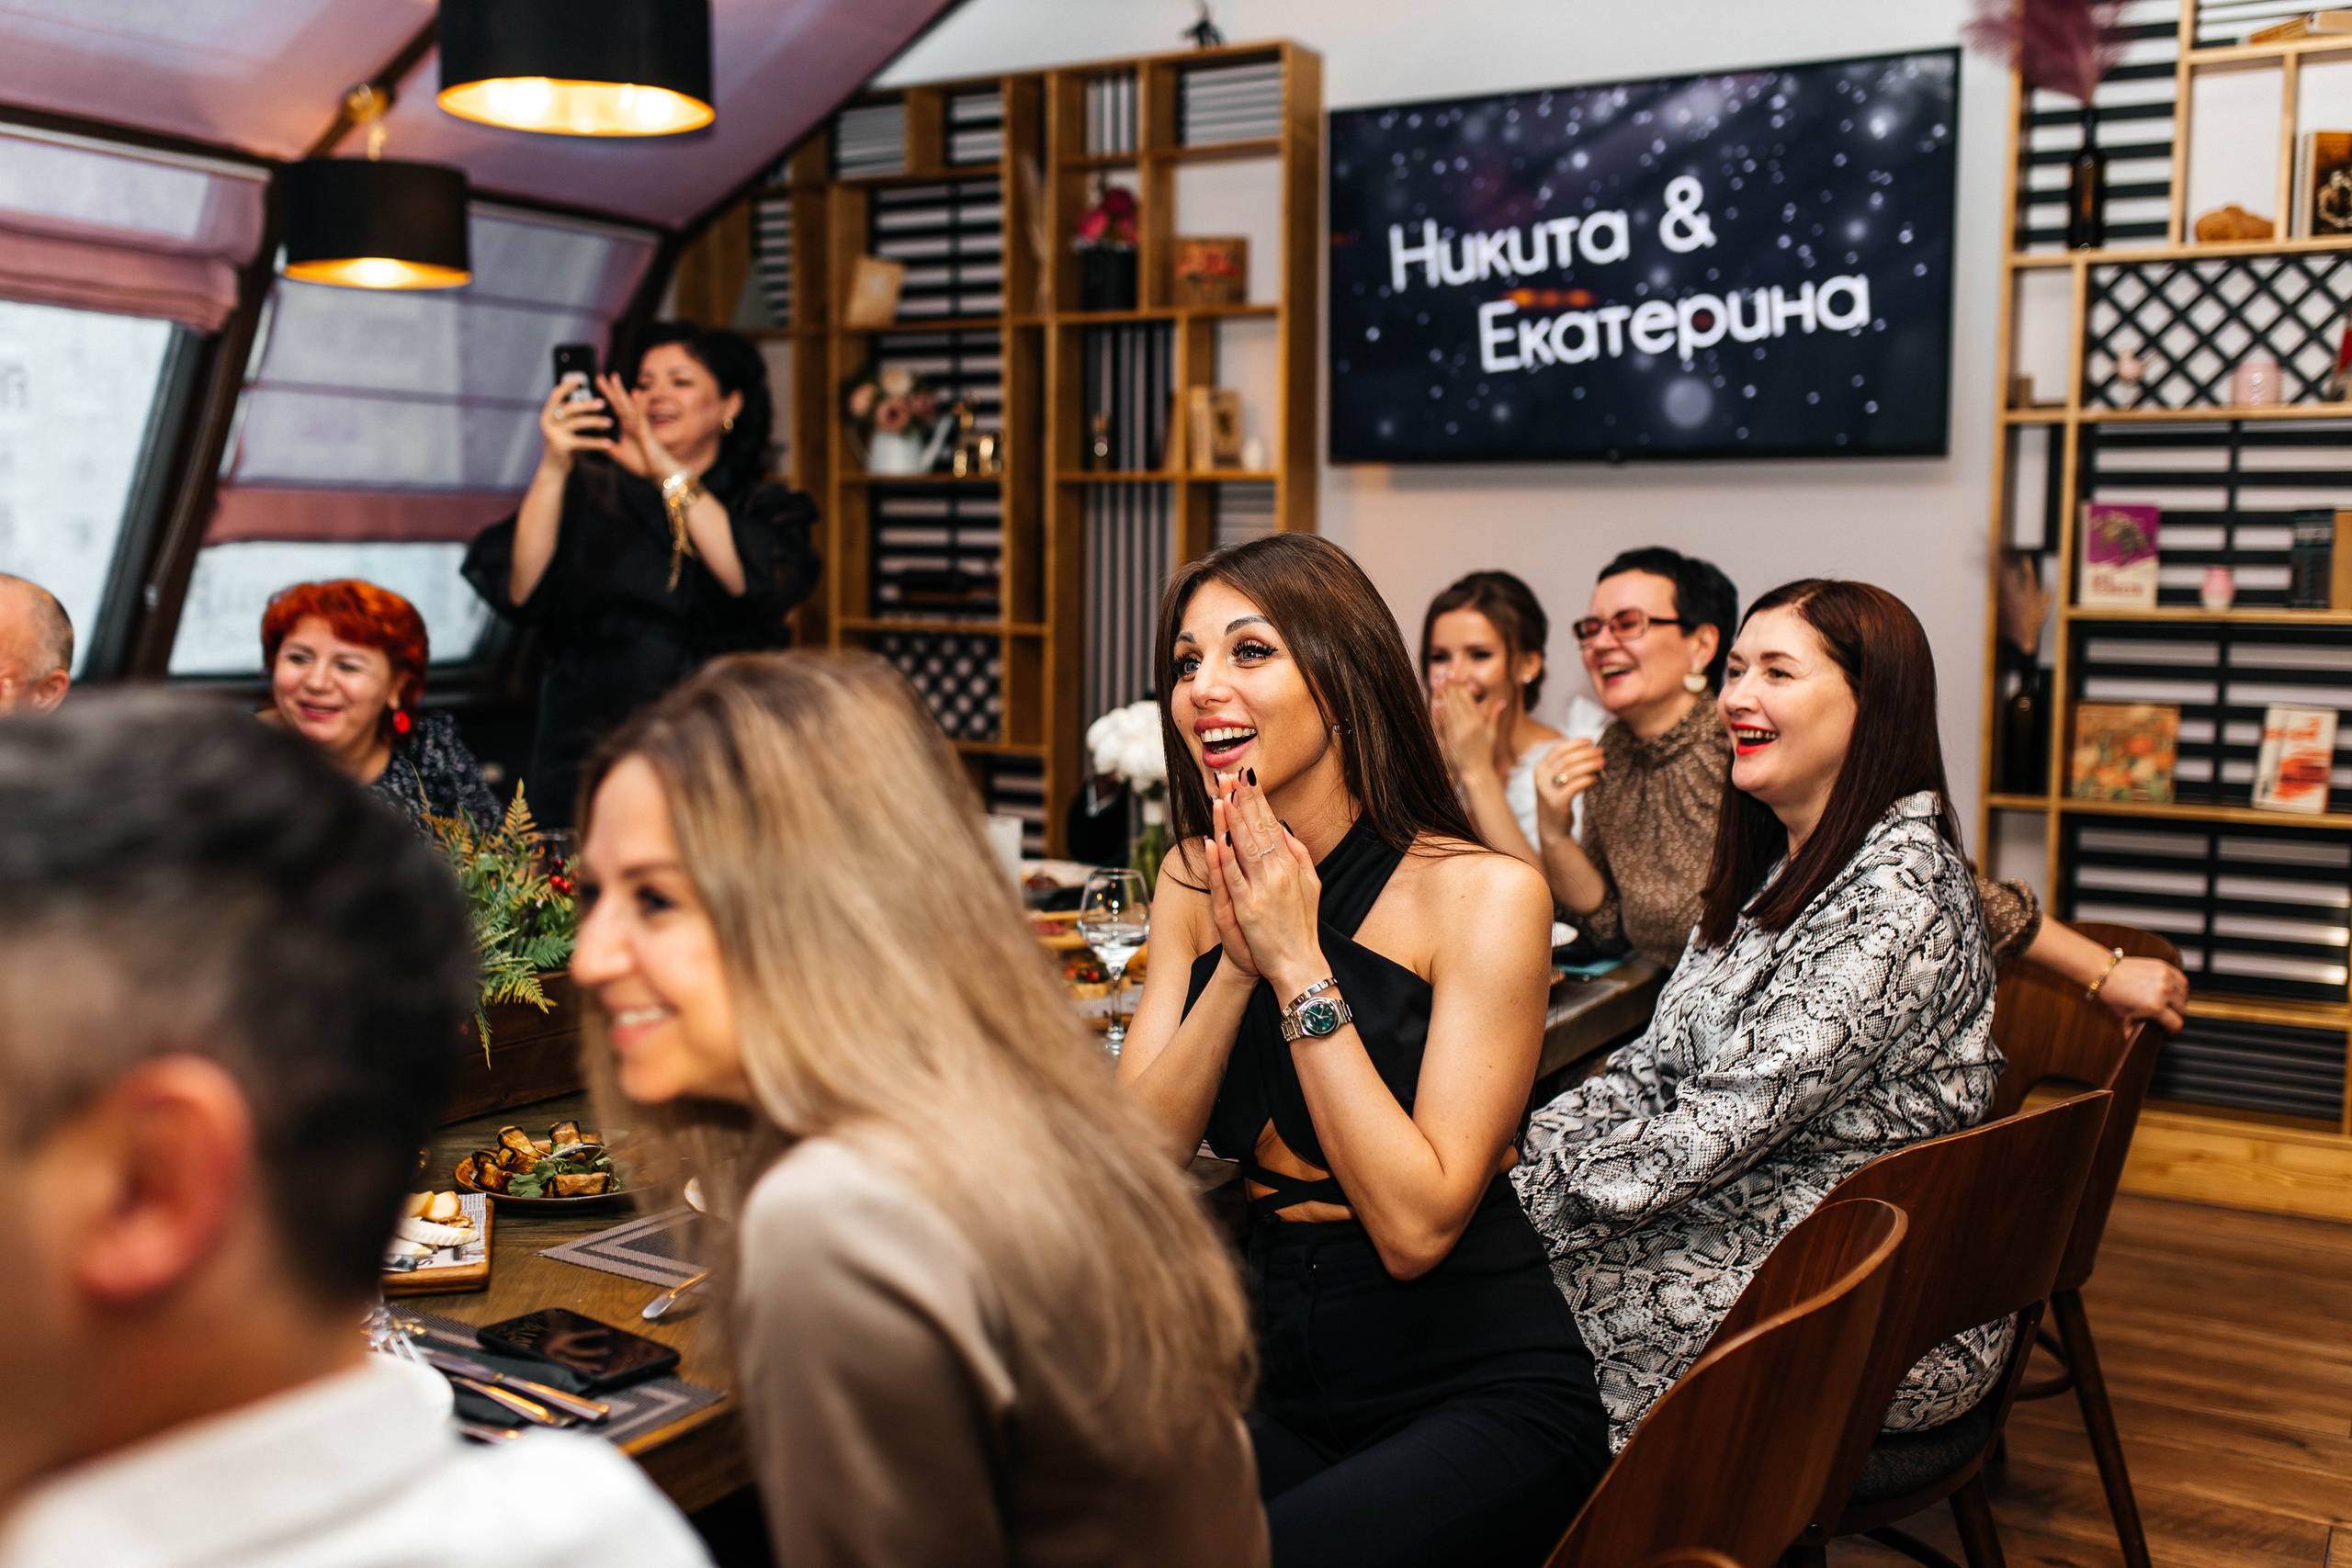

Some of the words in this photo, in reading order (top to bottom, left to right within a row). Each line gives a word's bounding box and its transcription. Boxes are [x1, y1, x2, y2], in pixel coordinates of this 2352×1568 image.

[1388, 209, 1630, 292] Никита
[1658, 175, 1716, 253] &
[1477, 274, 1871, 373] Екатерина
